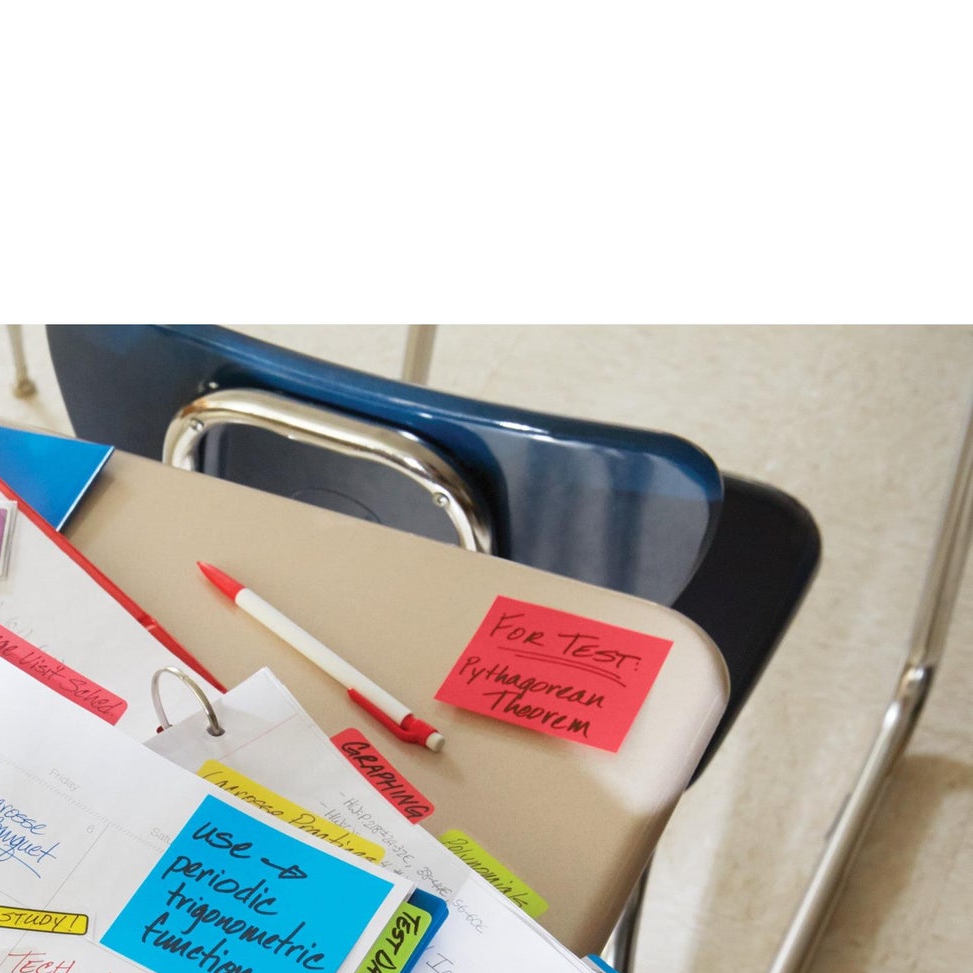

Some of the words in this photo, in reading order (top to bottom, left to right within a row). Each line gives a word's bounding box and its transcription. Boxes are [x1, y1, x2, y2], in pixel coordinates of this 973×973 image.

[19, 650, 68, 683] Visit
[489, 612, 545, 647] FOR
[557, 632, 643, 672] TEST:
[459, 655, 606, 709] Pythagorean
[483, 690, 591, 738] Theorem
[48, 767, 81, 793] Friday
[341, 741, 430, 821] GRAPHING
[192, 821, 253, 860] use
[160, 855, 278, 916] periodic
[167, 881, 325, 971] trigonometric
[385, 911, 422, 956] TEST
